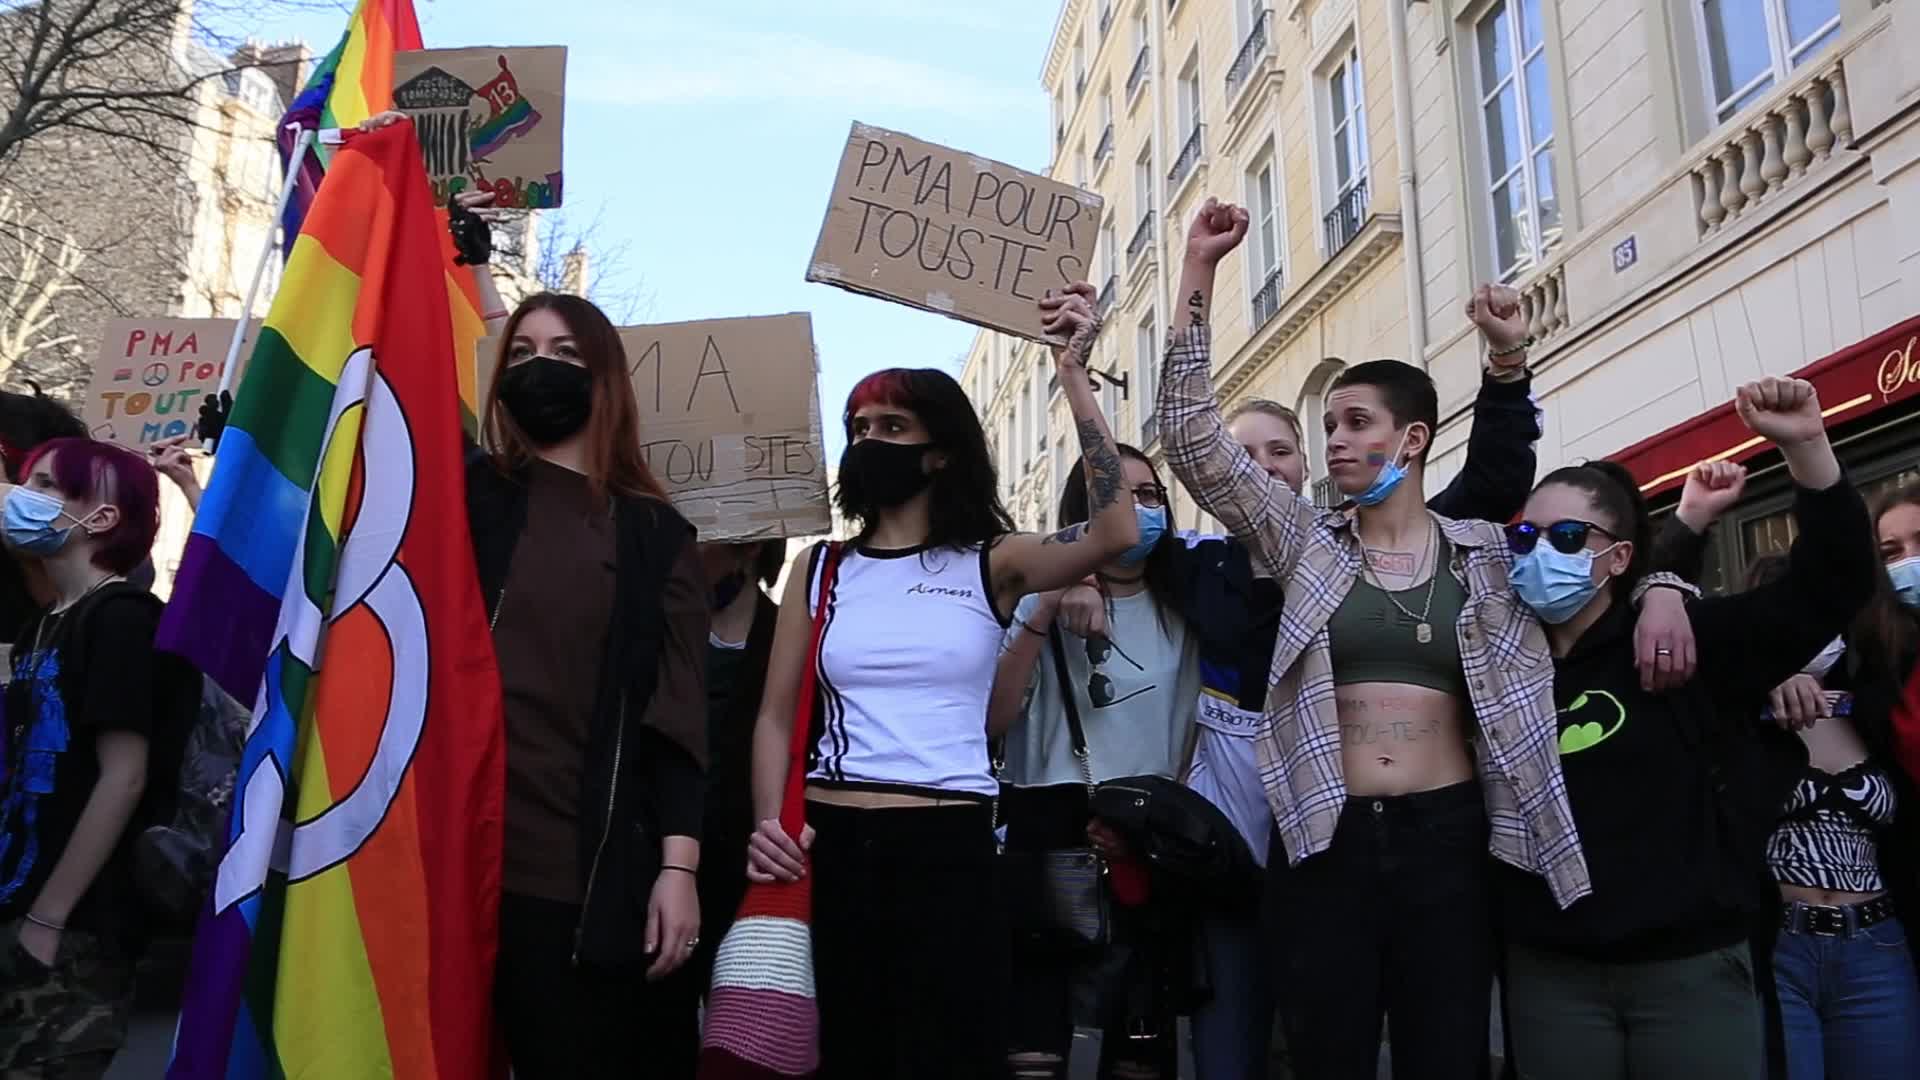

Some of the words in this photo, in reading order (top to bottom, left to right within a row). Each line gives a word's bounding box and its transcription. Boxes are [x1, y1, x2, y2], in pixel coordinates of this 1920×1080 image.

[489, 81, 515, 111] 13
[855, 140, 952, 214] PMA
[967, 171, 1082, 250] POUR
[1615, 240, 1633, 267] 85
[126, 329, 198, 357] PMA
[101, 388, 202, 419] TOUT
